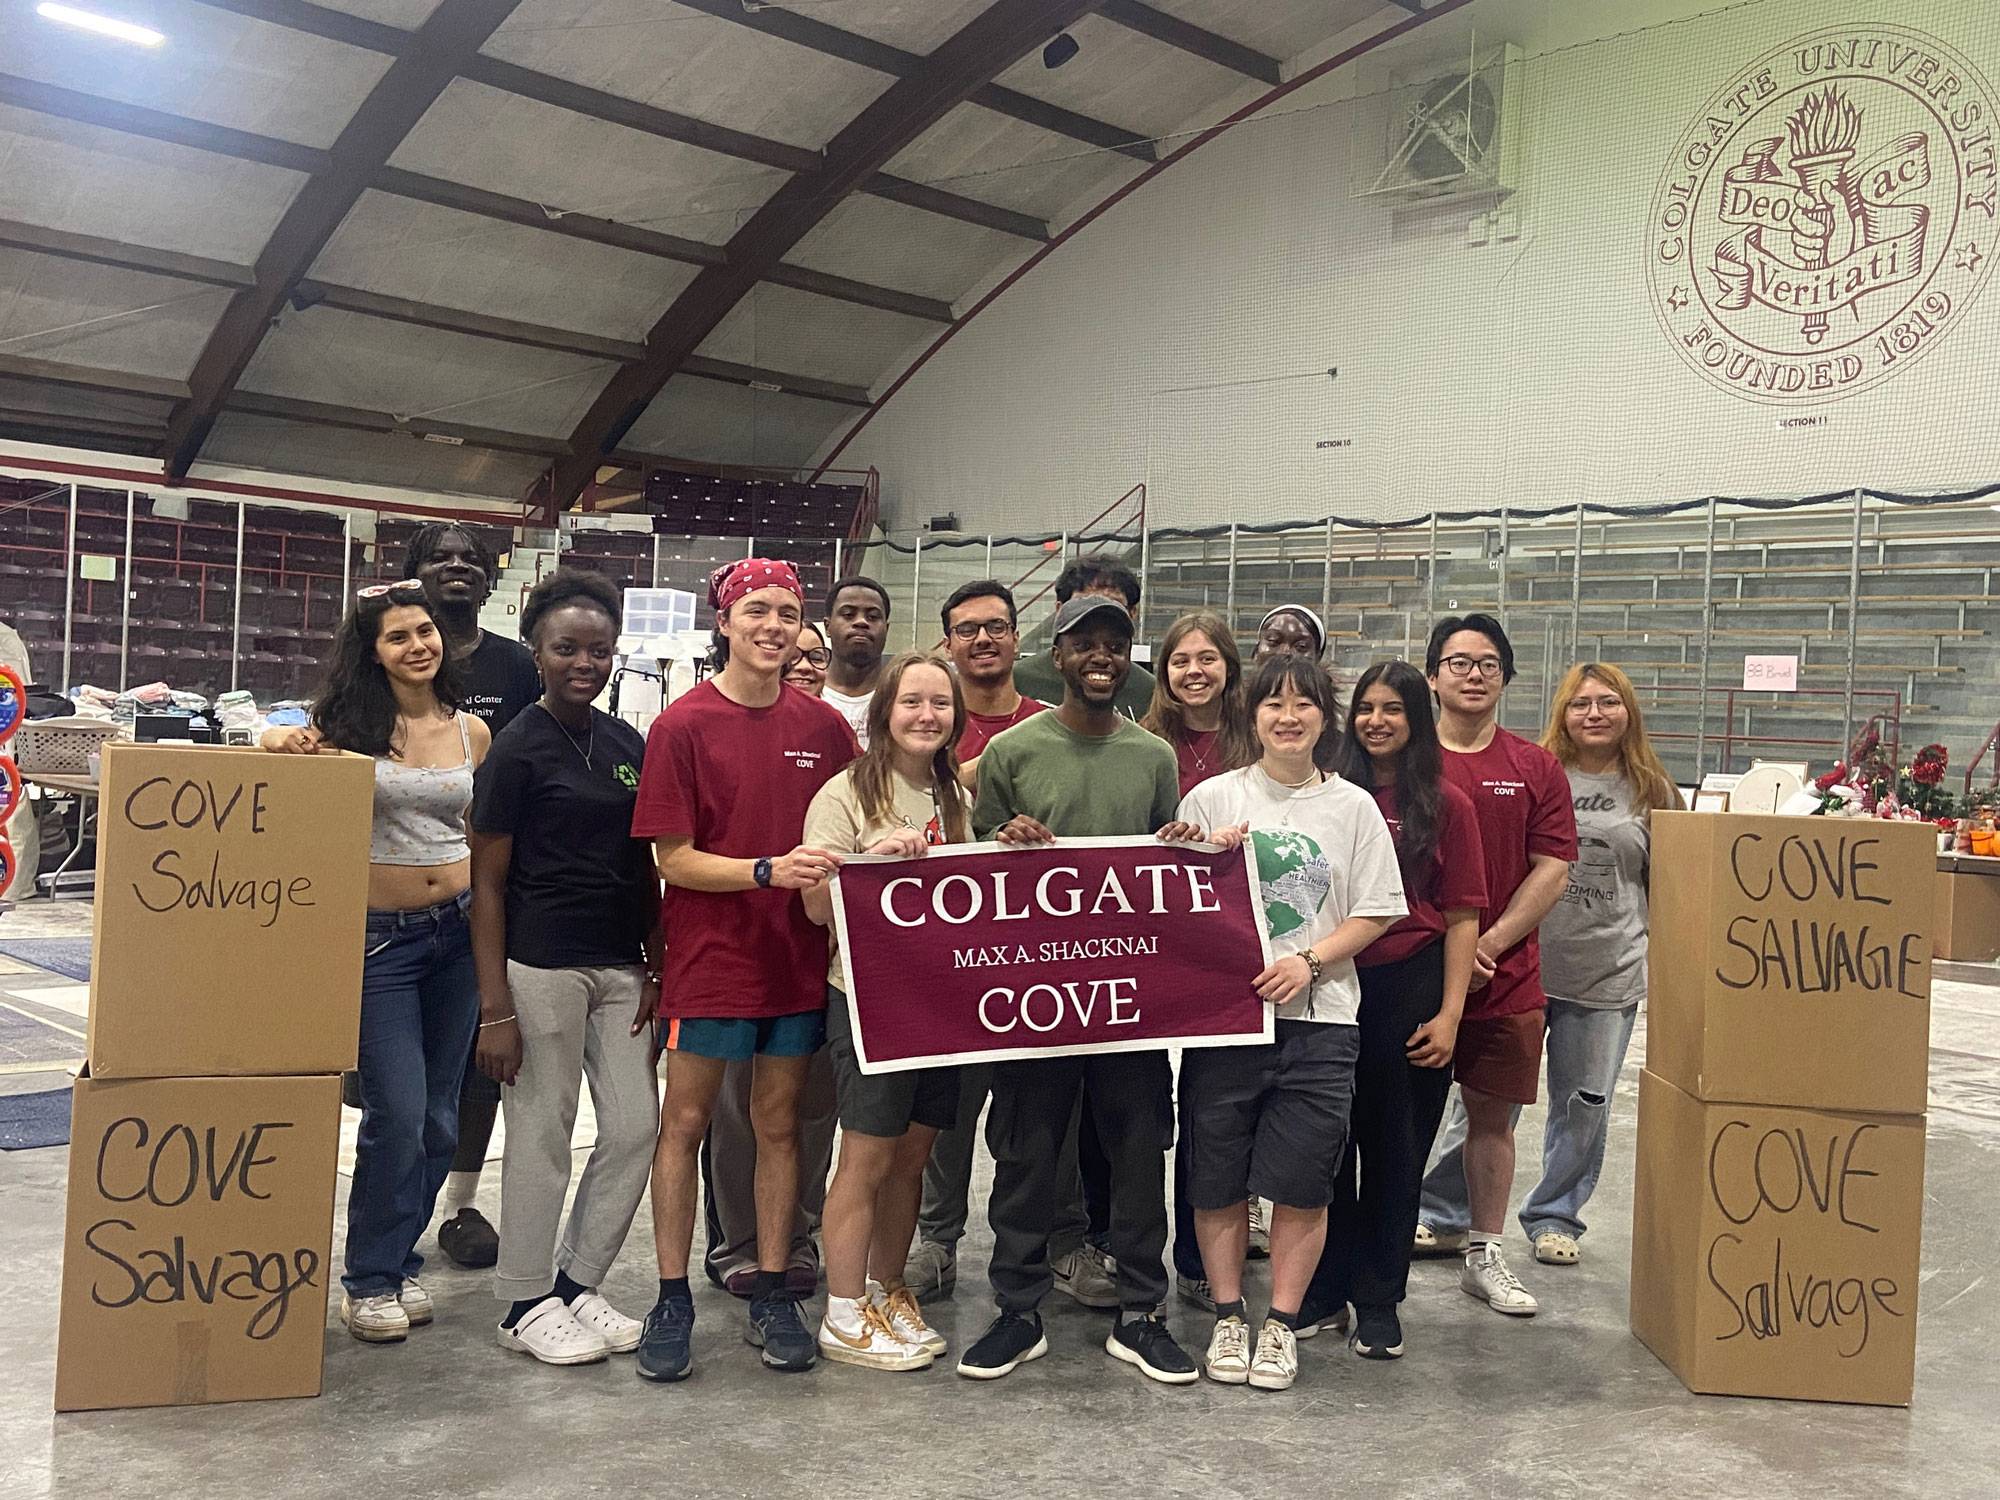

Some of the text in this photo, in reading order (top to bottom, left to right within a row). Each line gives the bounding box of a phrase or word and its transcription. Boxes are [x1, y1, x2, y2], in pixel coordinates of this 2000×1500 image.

[1658, 39, 1997, 265] COLGATE UNIVERSITY
[1873, 159, 1918, 199] ac
[1729, 187, 1790, 222] Deo
[1757, 242, 1900, 307] Veritati
[1683, 291, 1951, 392] FOUNDED 1819
[1316, 439, 1352, 449] SECTION 10
[570, 517, 578, 529] H
[507, 604, 517, 616] D
[469, 708, 494, 718] Unity
[474, 694, 503, 704] Center
[796, 759, 814, 769] COVE
[1494, 787, 1516, 796] COVE
[124, 776, 268, 833] COVE
[132, 850, 316, 927] Salvage
[1288, 872, 1329, 888] HEALTHIER
[1306, 858, 1329, 870] safer
[1731, 833, 1892, 905] COVE
[880, 864, 1221, 928] COLGATE
[953, 936, 1159, 969] MAX A. SHACKNAI
[1715, 916, 1926, 999] SALVAGE
[978, 977, 1141, 1033] COVE
[97, 1117, 294, 1207] COVE
[1709, 1121, 1880, 1233] COVE
[85, 1219, 320, 1340] Salvage
[1707, 1233, 1904, 1358] Salvage
